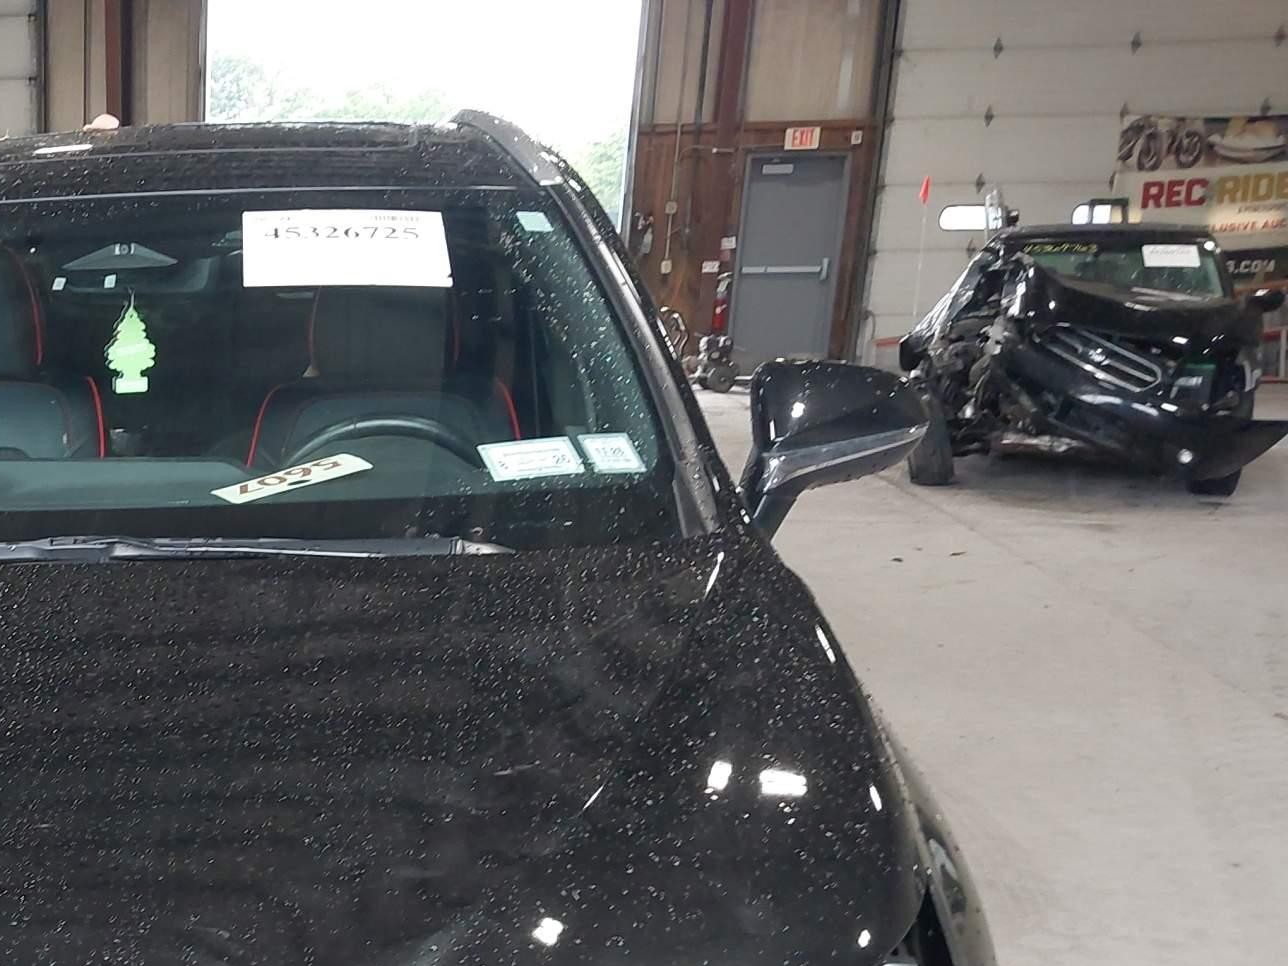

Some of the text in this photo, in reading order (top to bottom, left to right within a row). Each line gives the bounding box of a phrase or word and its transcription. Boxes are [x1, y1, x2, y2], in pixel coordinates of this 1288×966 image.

[792, 127, 815, 147] EXIT
[1141, 178, 1210, 209] REC
[264, 225, 420, 240] 45326725
